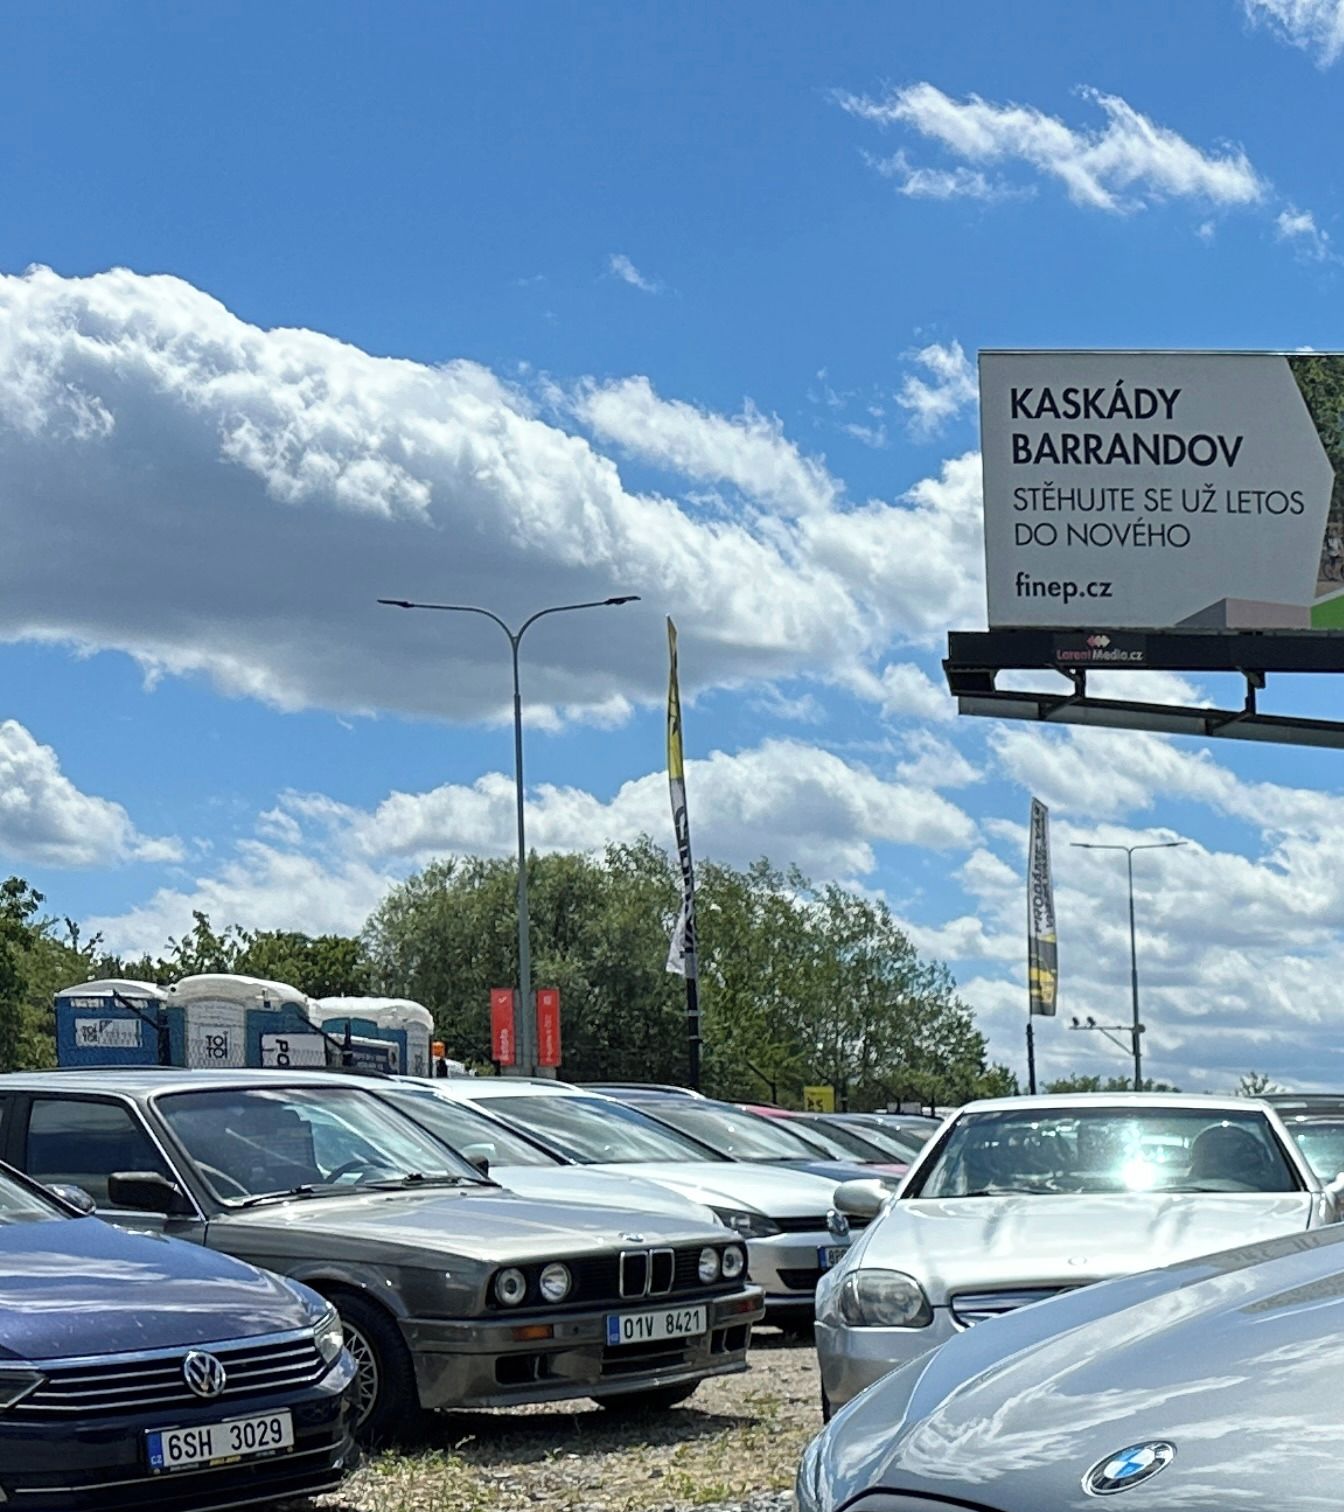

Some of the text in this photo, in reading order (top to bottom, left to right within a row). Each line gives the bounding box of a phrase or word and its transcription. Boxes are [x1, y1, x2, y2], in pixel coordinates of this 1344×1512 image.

[1011, 379, 1181, 419] KASKÁDY
[1013, 433, 1243, 467] BARRANDOV
[1014, 481, 1304, 515] STĚHUJTE SE UŽ LETOS
[1014, 517, 1191, 548] DO NOVÉHO
[1015, 572, 1112, 604] finep.cz
[623, 1310, 700, 1339] 01V 8421
[168, 1418, 283, 1461] 6SH 3029
